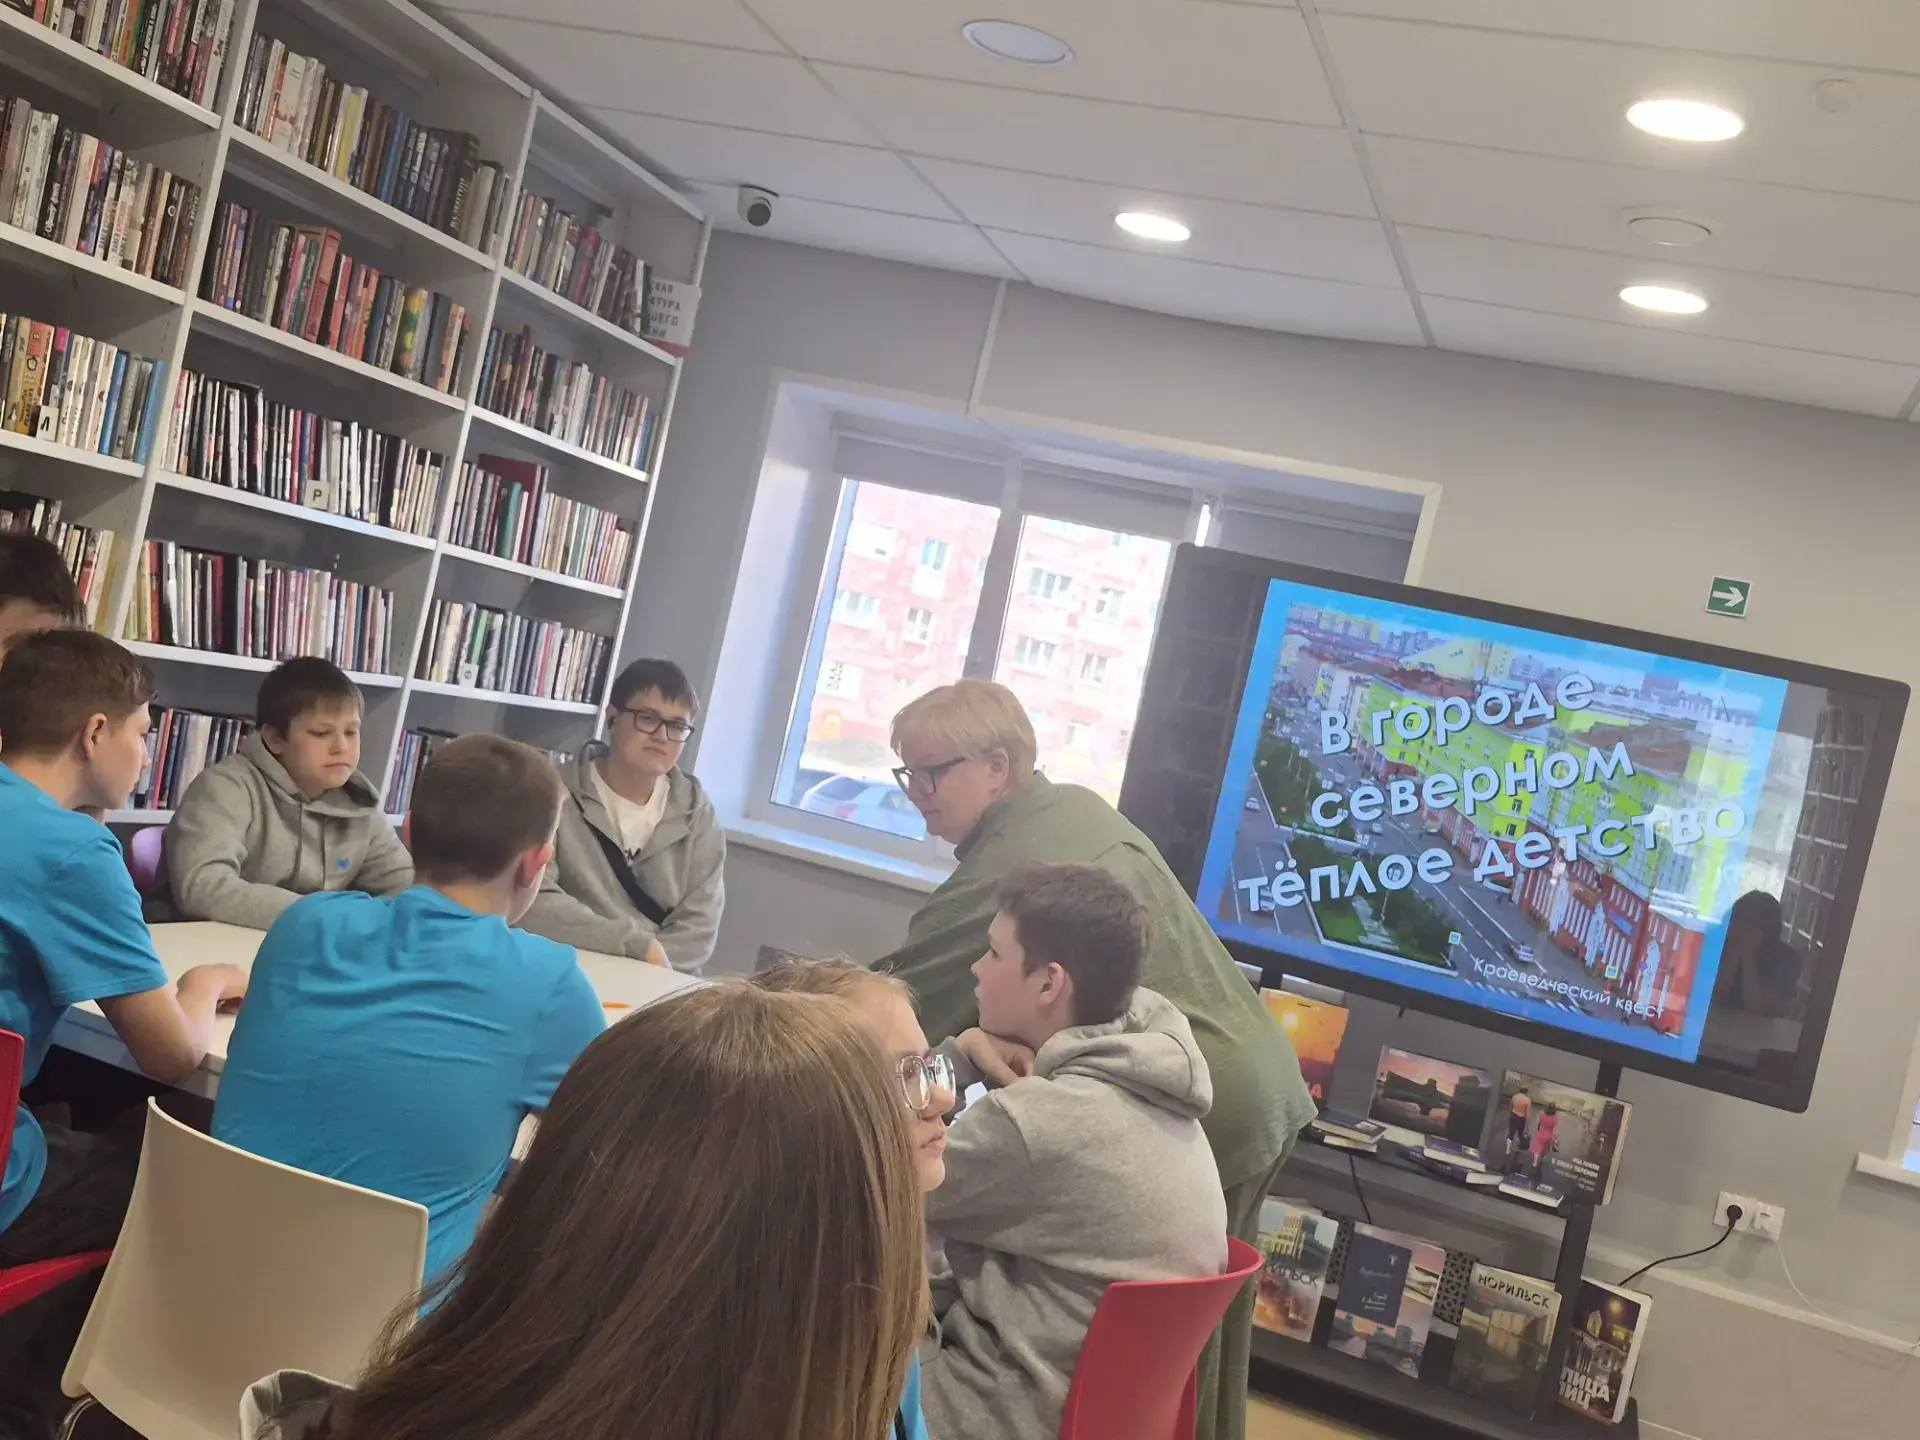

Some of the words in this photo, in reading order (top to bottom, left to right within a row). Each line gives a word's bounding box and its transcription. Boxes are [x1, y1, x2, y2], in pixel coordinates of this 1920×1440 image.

[1320, 708, 1351, 756] В
[1372, 673, 1596, 747] городе
[1311, 741, 1635, 828] северном
[1238, 846, 1453, 912] тёплое
[1473, 801, 1747, 883] детство
[1473, 957, 1611, 1006] Краеведческий
[1615, 999, 1665, 1020] квест
[1478, 1273, 1550, 1309] НОРИЛЬСК
